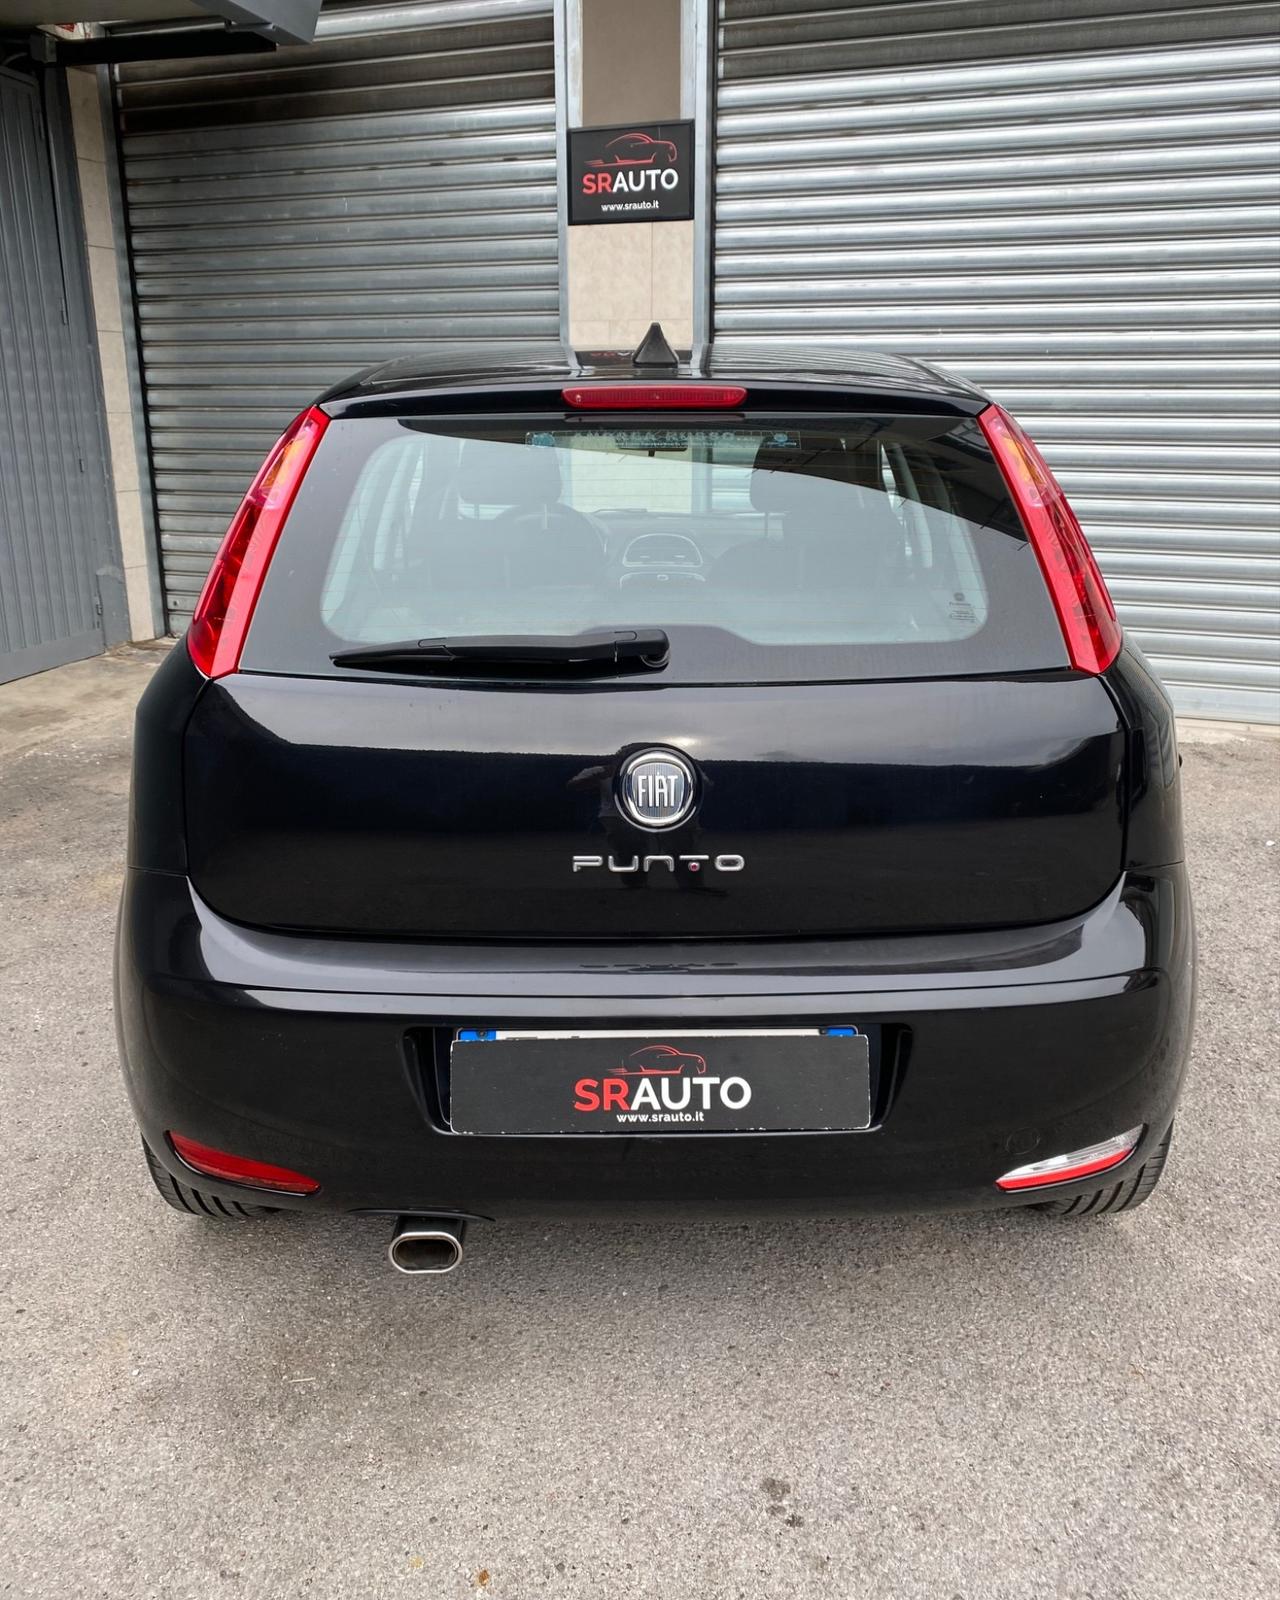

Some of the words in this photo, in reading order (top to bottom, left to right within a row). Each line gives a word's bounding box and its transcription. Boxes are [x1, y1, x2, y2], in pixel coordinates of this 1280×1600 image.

[582, 168, 679, 194] SRAUTO
[600, 200, 660, 212] www.srauto.it
[636, 771, 679, 809] FIAT
[572, 854, 745, 873] PUNTO
[574, 1076, 752, 1112] SRAUTO
[616, 1111, 705, 1123] www.srauto.it
